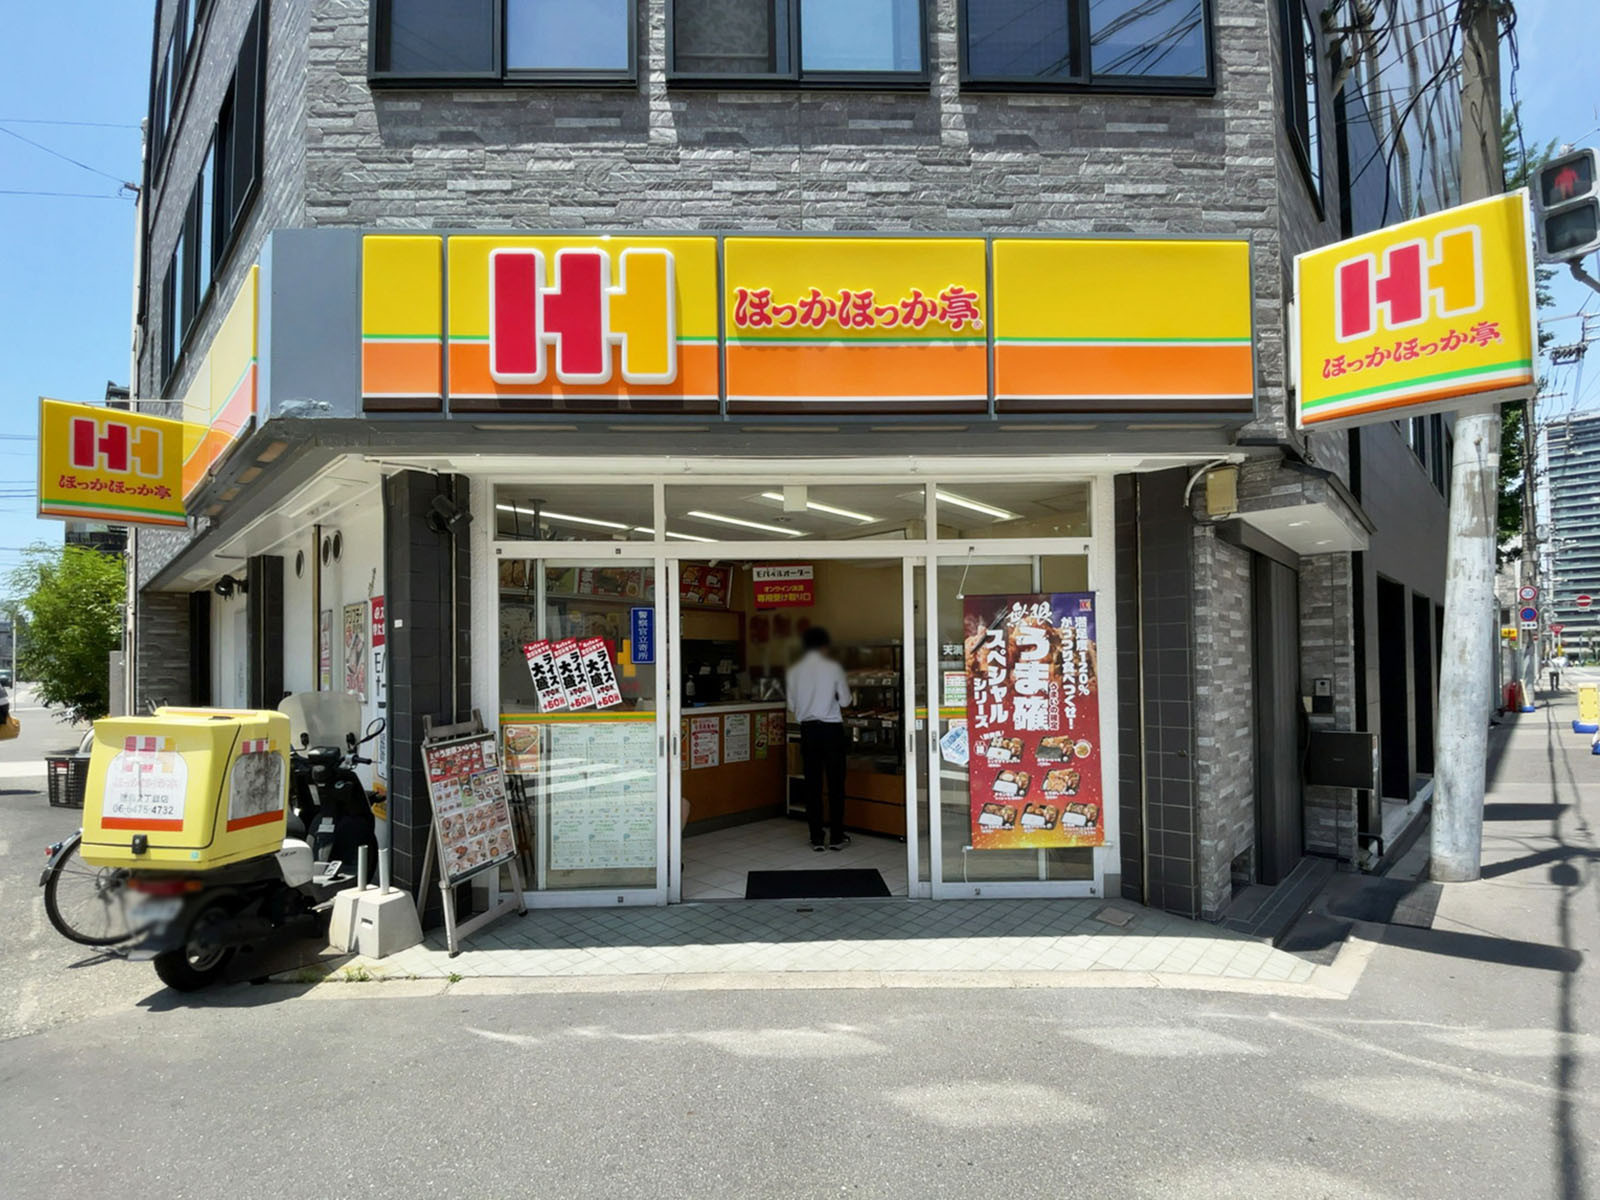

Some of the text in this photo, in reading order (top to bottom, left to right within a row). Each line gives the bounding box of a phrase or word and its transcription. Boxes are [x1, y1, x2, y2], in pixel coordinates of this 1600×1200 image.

[735, 284, 979, 331] ほっかほっか亭
[1322, 321, 1500, 380] ほっかほっか亭
[59, 475, 172, 500] ほっかほっか亭
[531, 662, 550, 691] 大盛
[542, 653, 560, 687] ライス
[559, 661, 577, 689] 大盛
[570, 651, 587, 685] ライス
[586, 659, 605, 688] 大盛
[597, 650, 614, 683] ライス
[985, 629, 1009, 724] スペシャル
[1013, 626, 1050, 731] うま確
